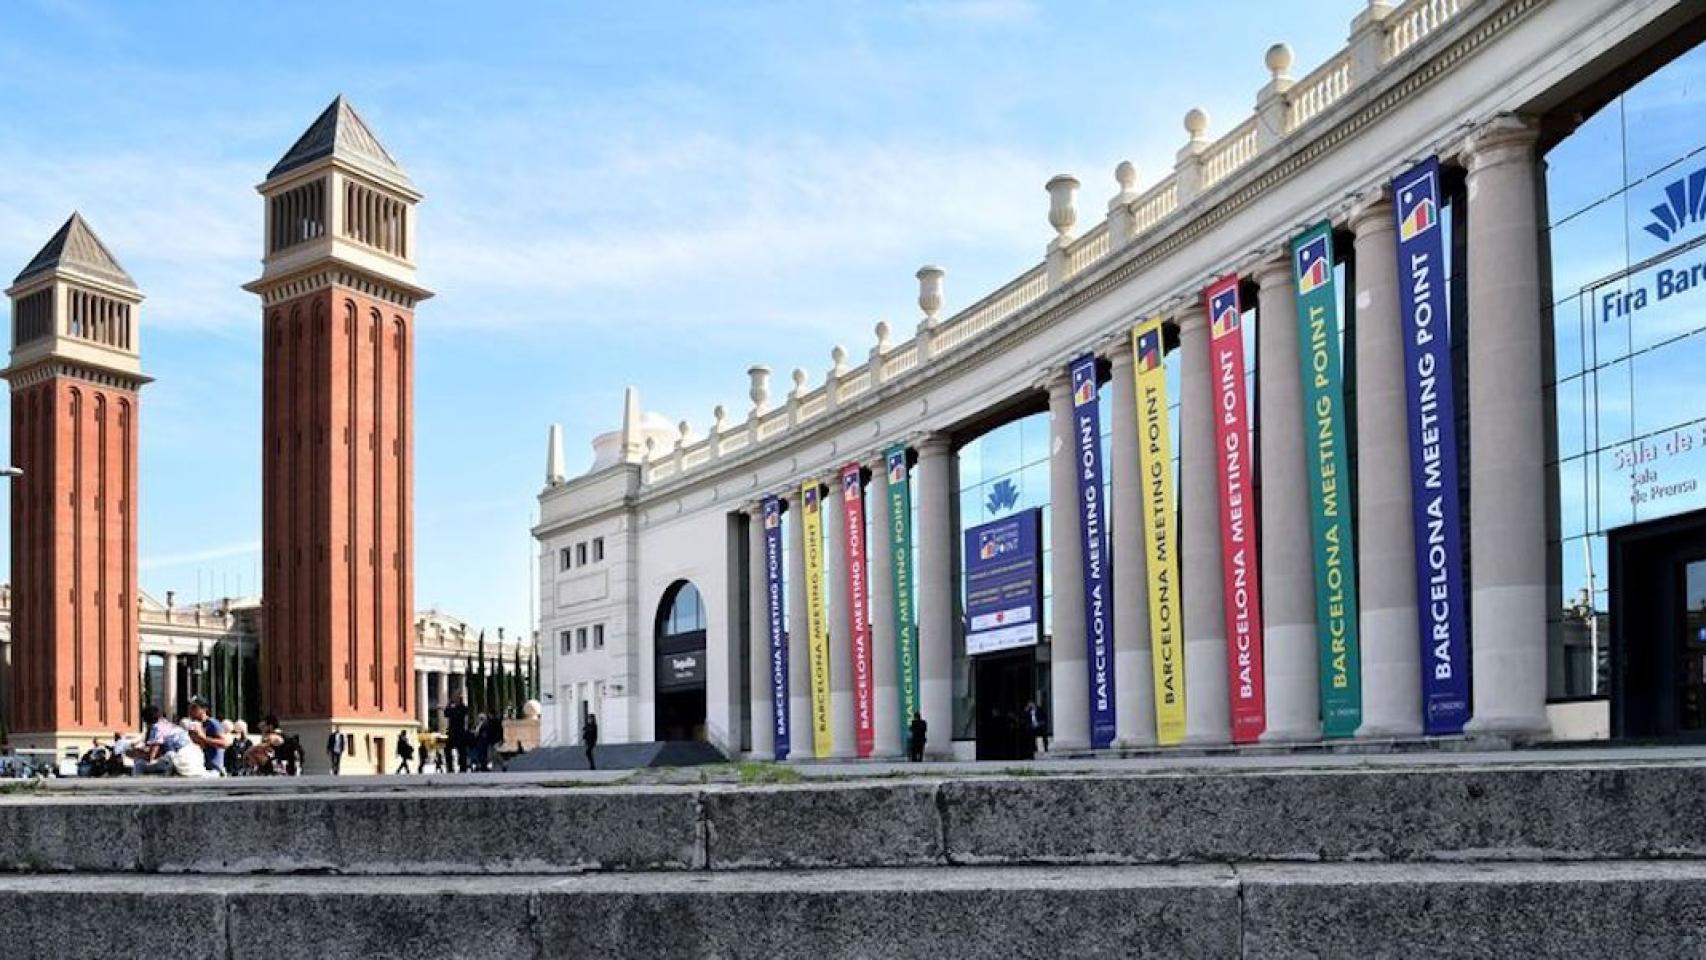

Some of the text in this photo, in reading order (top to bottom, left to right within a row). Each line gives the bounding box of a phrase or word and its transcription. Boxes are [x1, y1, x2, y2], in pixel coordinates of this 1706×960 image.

[1411, 253, 1434, 346] POINT
[1602, 262, 1706, 323] Fira Bar
[1220, 350, 1238, 425] POINT
[1310, 305, 1330, 389] POINT
[1080, 416, 1095, 480] POINT
[1145, 386, 1160, 453] POINT
[1315, 395, 1338, 517] MEETING
[1418, 352, 1442, 488] MEETING
[1614, 440, 1657, 472] Sala
[1666, 431, 1693, 456] de
[893, 493, 905, 543] POINT
[1086, 485, 1101, 579] MEETING
[1151, 461, 1167, 561] MEETING
[1226, 432, 1244, 542] MEETING
[768, 537, 786, 735] BARCELONA MEETING POINT
[808, 525, 827, 732] BARCELONA MEETING POINT
[848, 511, 870, 729] BARCELONA MEETING POINT
[896, 548, 909, 621] MEETING
[1157, 569, 1175, 704] BARCELONA
[1233, 550, 1253, 699] BARCELONA
[1324, 524, 1348, 688] BARCELONA
[1426, 496, 1452, 680] BARCELONA
[1092, 584, 1108, 712] BARCELONA
